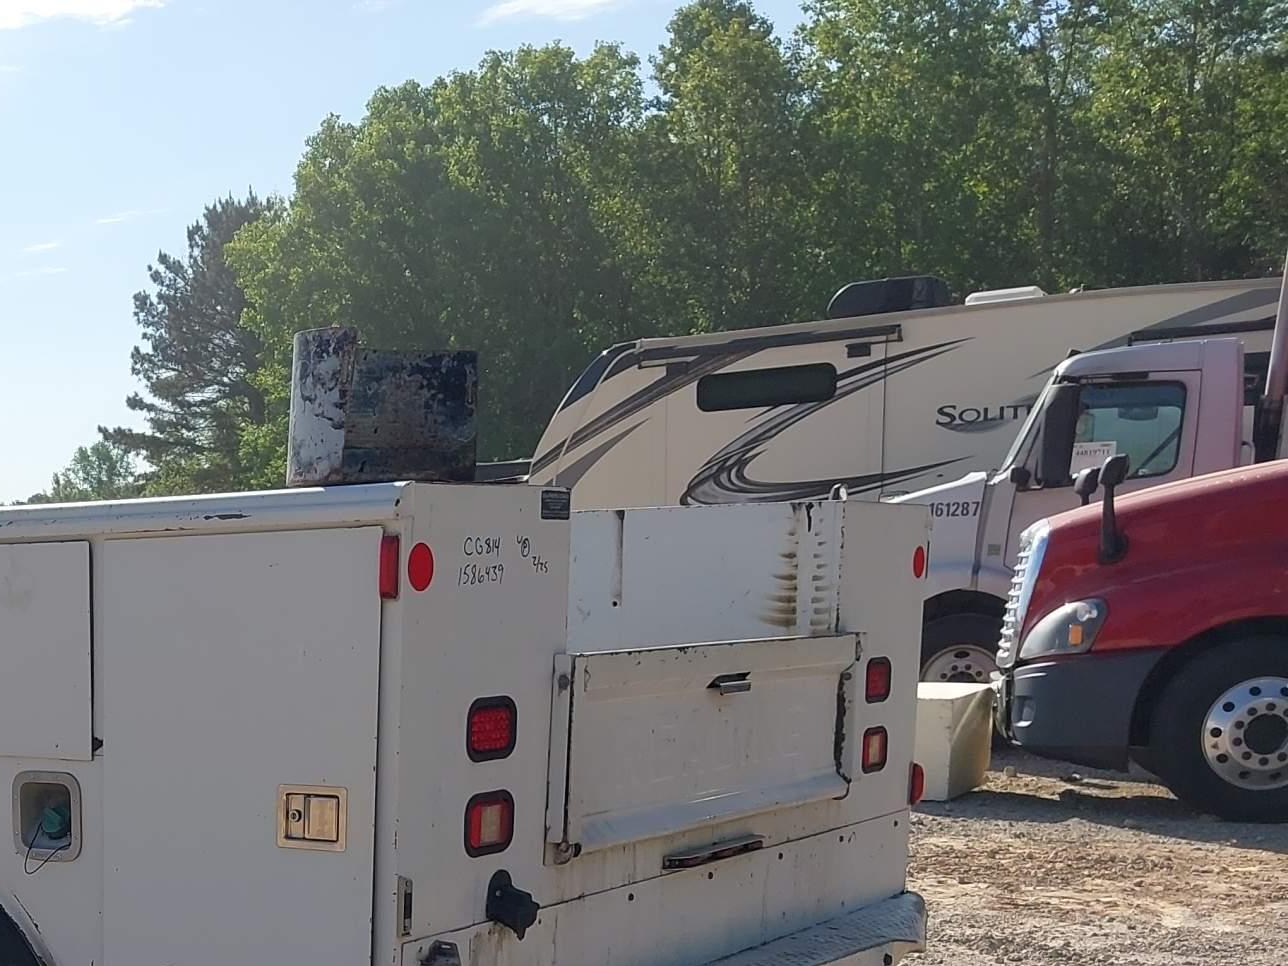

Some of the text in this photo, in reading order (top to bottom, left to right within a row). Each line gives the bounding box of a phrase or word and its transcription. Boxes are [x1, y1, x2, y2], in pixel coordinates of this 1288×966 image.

[929, 500, 981, 518] 161287
[463, 536, 501, 559] CG814
[457, 563, 505, 587] 1586439
